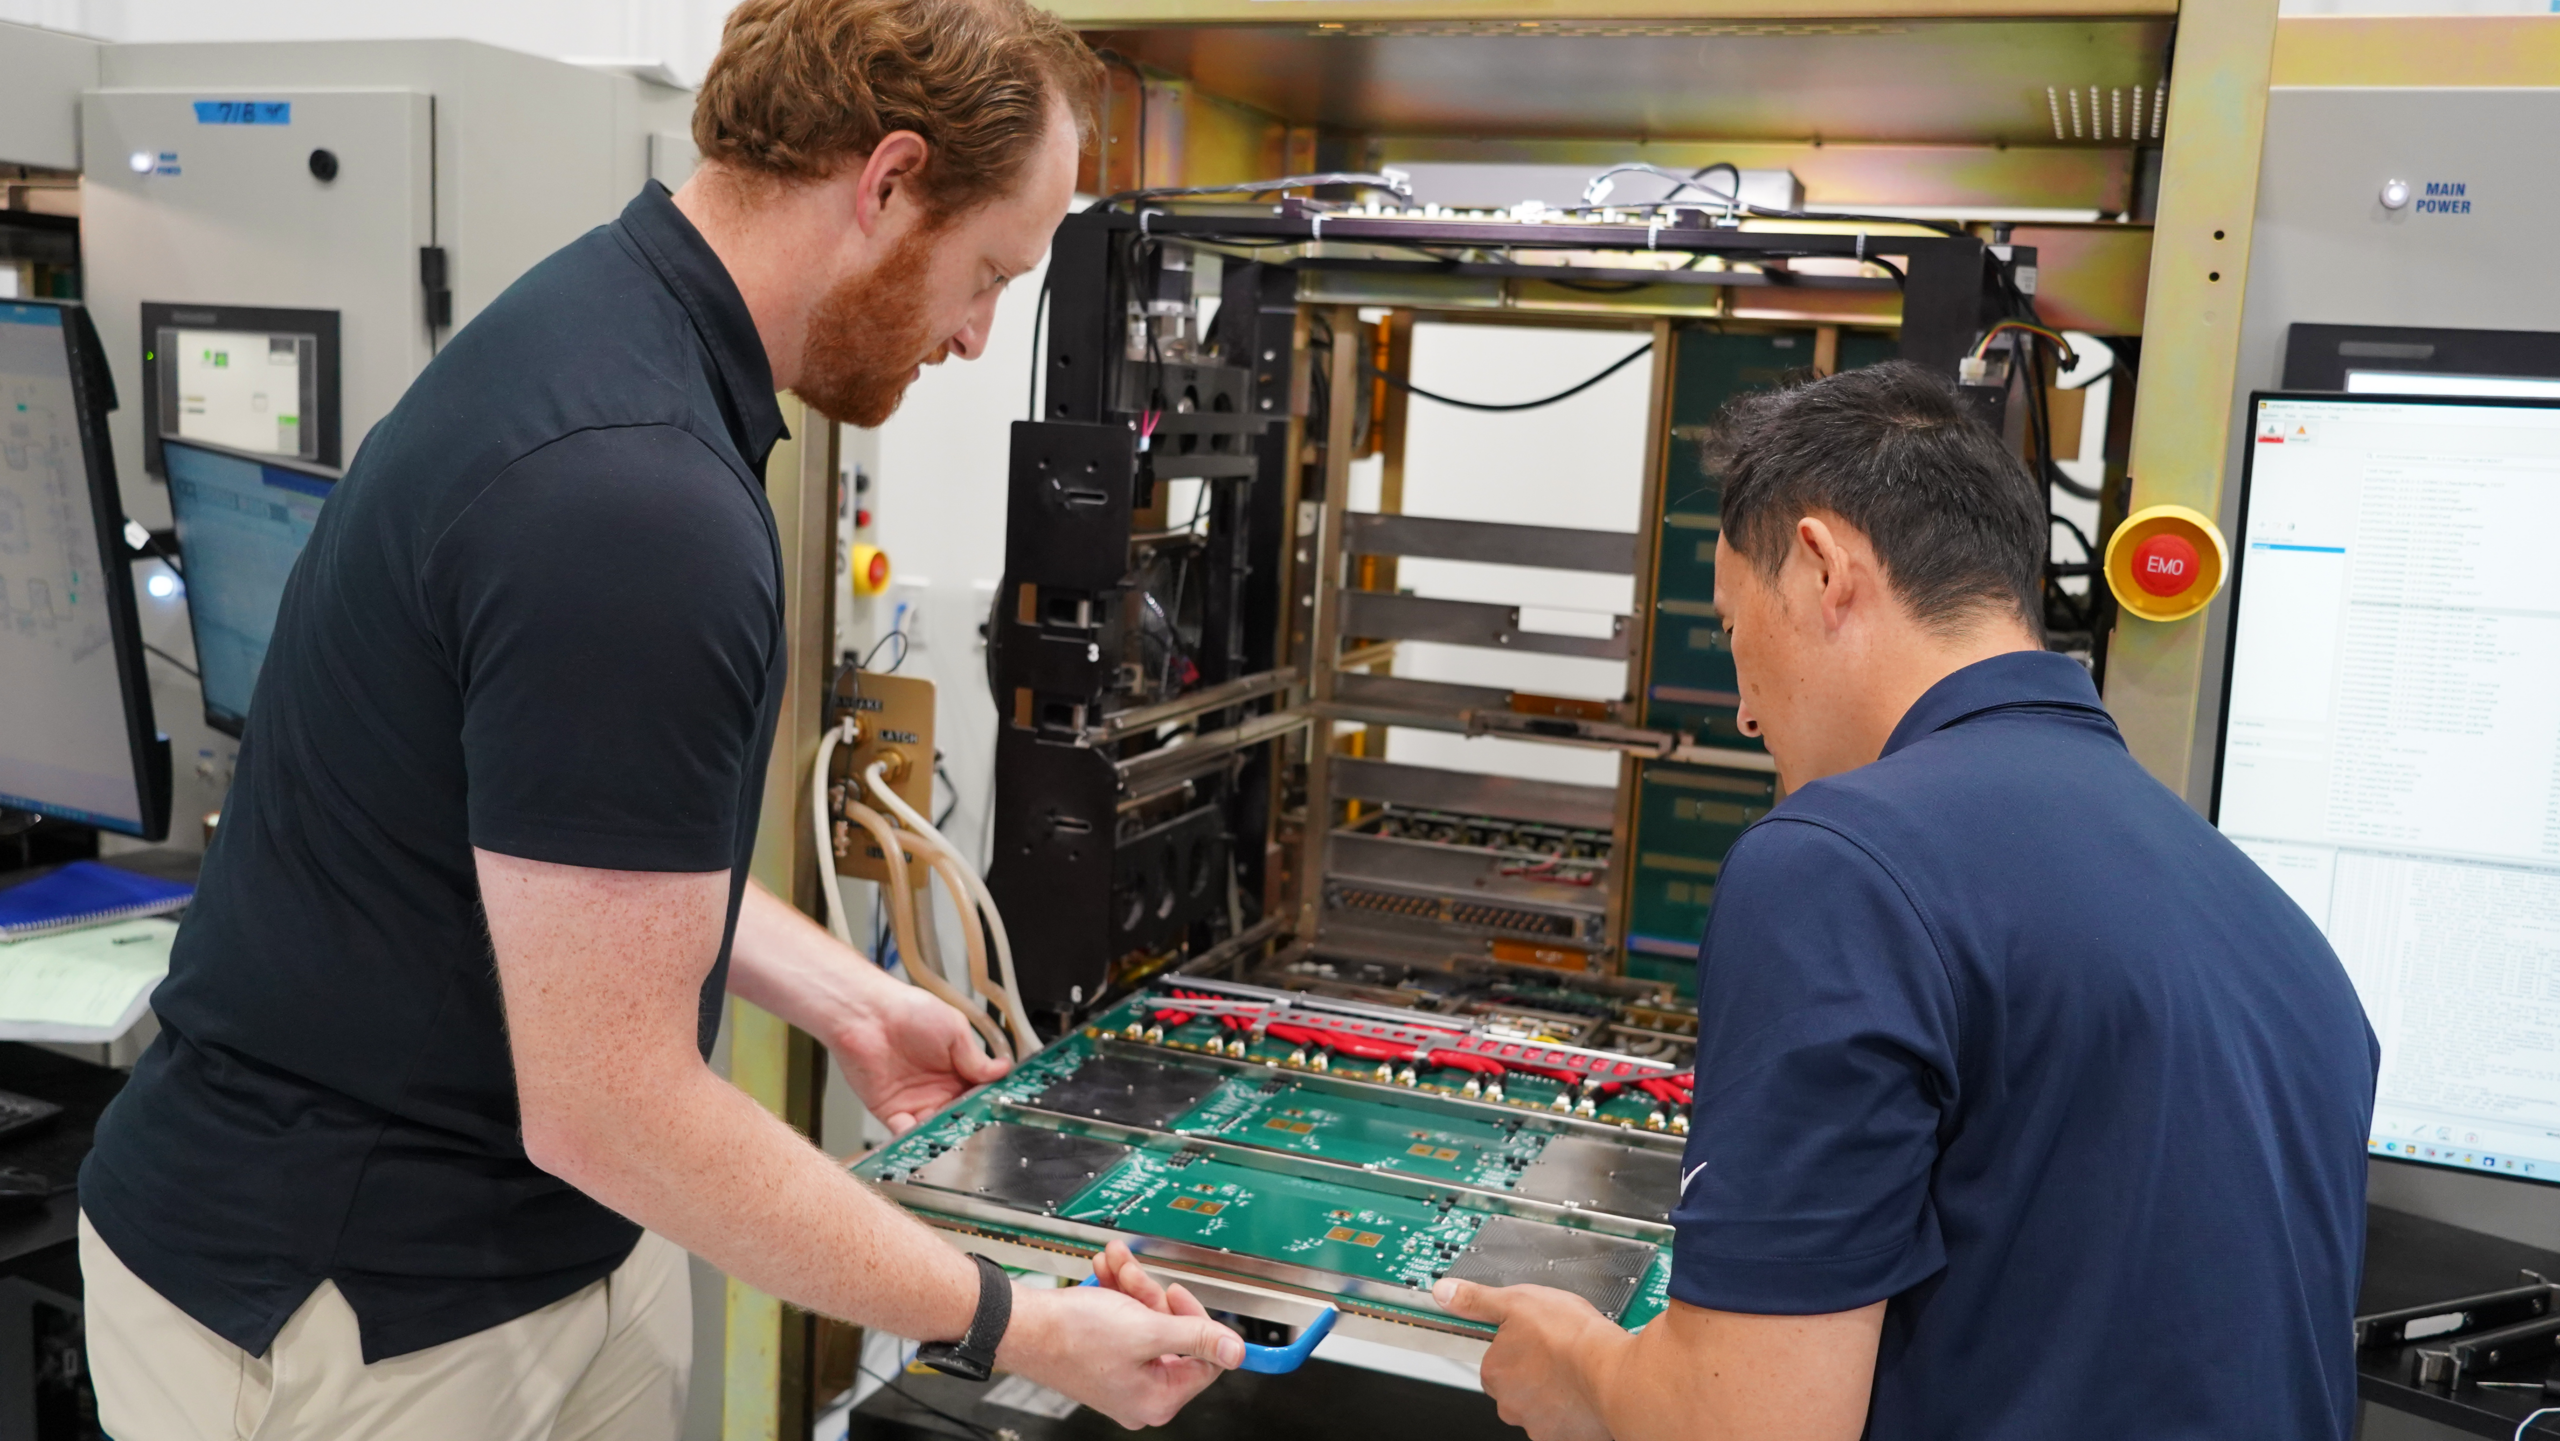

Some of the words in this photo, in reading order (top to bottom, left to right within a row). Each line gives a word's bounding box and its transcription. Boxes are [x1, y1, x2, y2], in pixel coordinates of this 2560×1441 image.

[2426, 182, 2467, 197] MAIN
[2416, 199, 2471, 214] POWER
[2146, 555, 2184, 576] EMO
[1087, 642, 1100, 663] 3
[880, 729, 919, 744] LATCH
[1070, 984, 1083, 1004] 6
